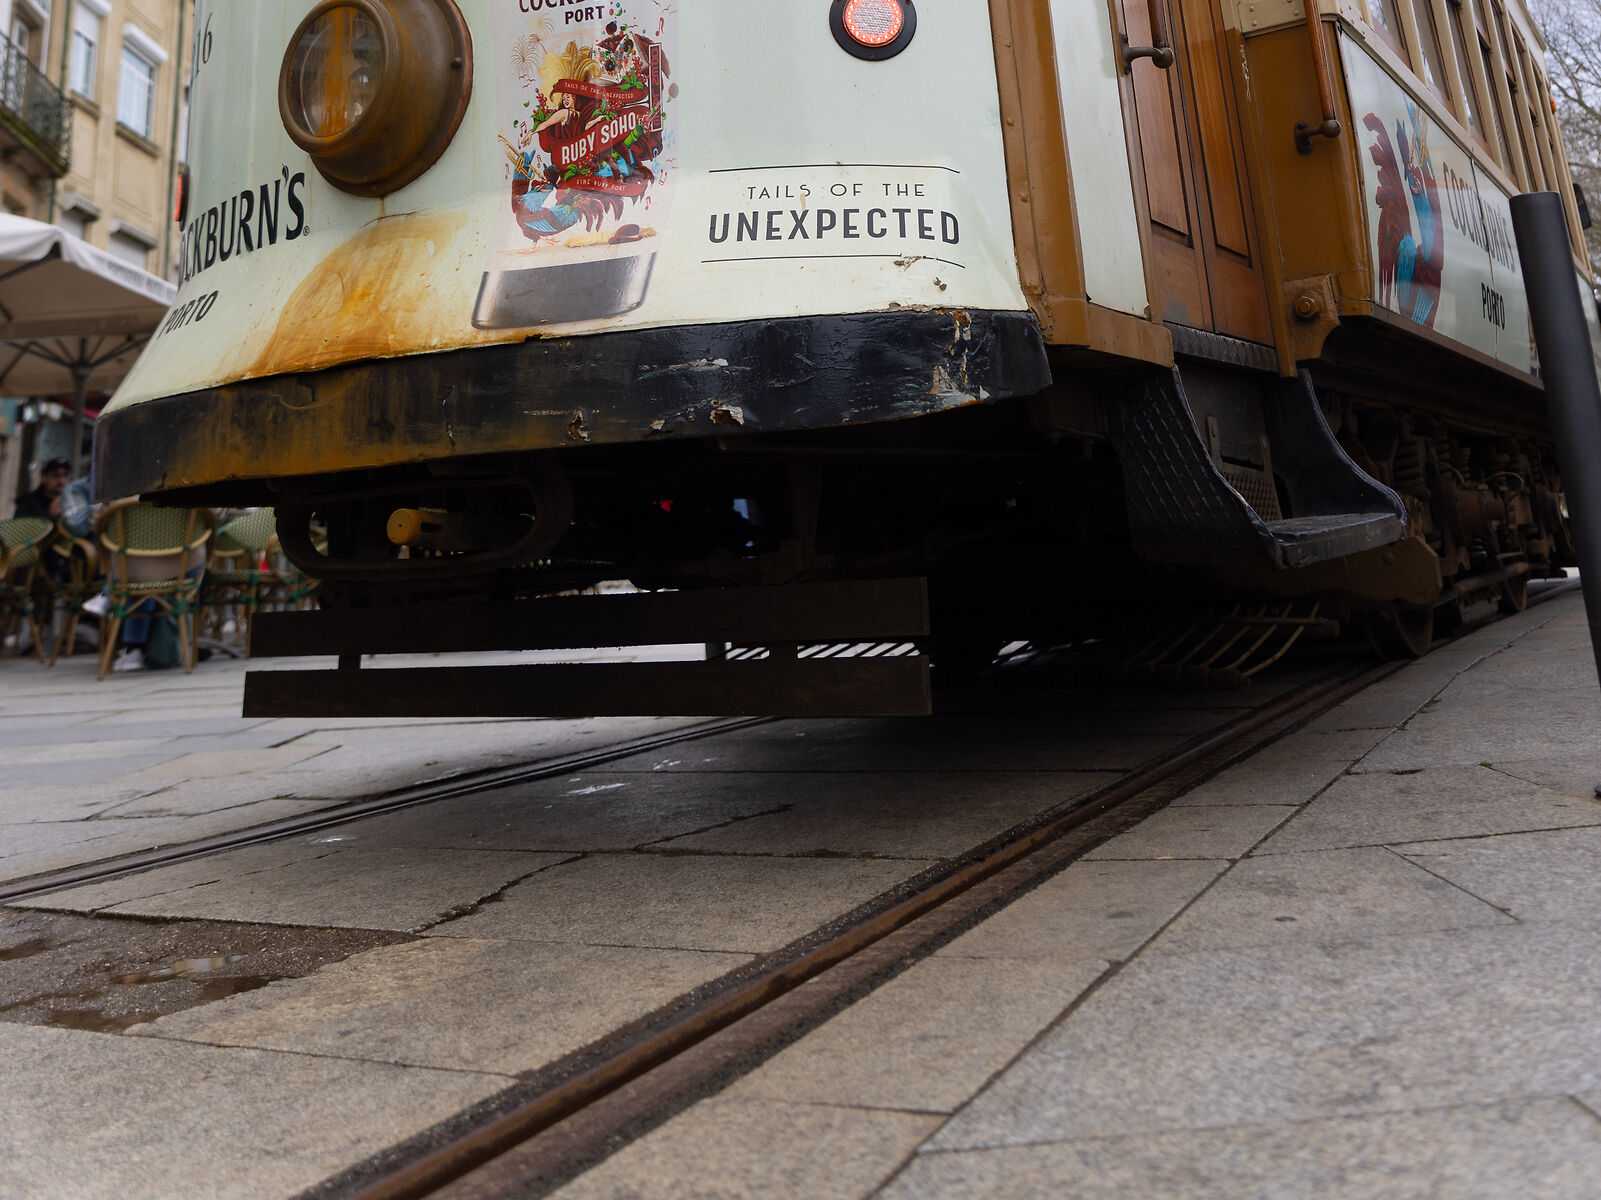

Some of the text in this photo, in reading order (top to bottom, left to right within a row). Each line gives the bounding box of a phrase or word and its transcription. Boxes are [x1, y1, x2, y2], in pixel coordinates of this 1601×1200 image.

[564, 5, 606, 25] PORT
[561, 111, 637, 165] RUBY SOHO
[747, 183, 925, 200] TAILS OF THE
[178, 163, 306, 291] OCKBURN'S
[708, 207, 960, 245] UNEXPECTED
[157, 290, 219, 339] PORTO
[1481, 282, 1506, 331] PORTO
